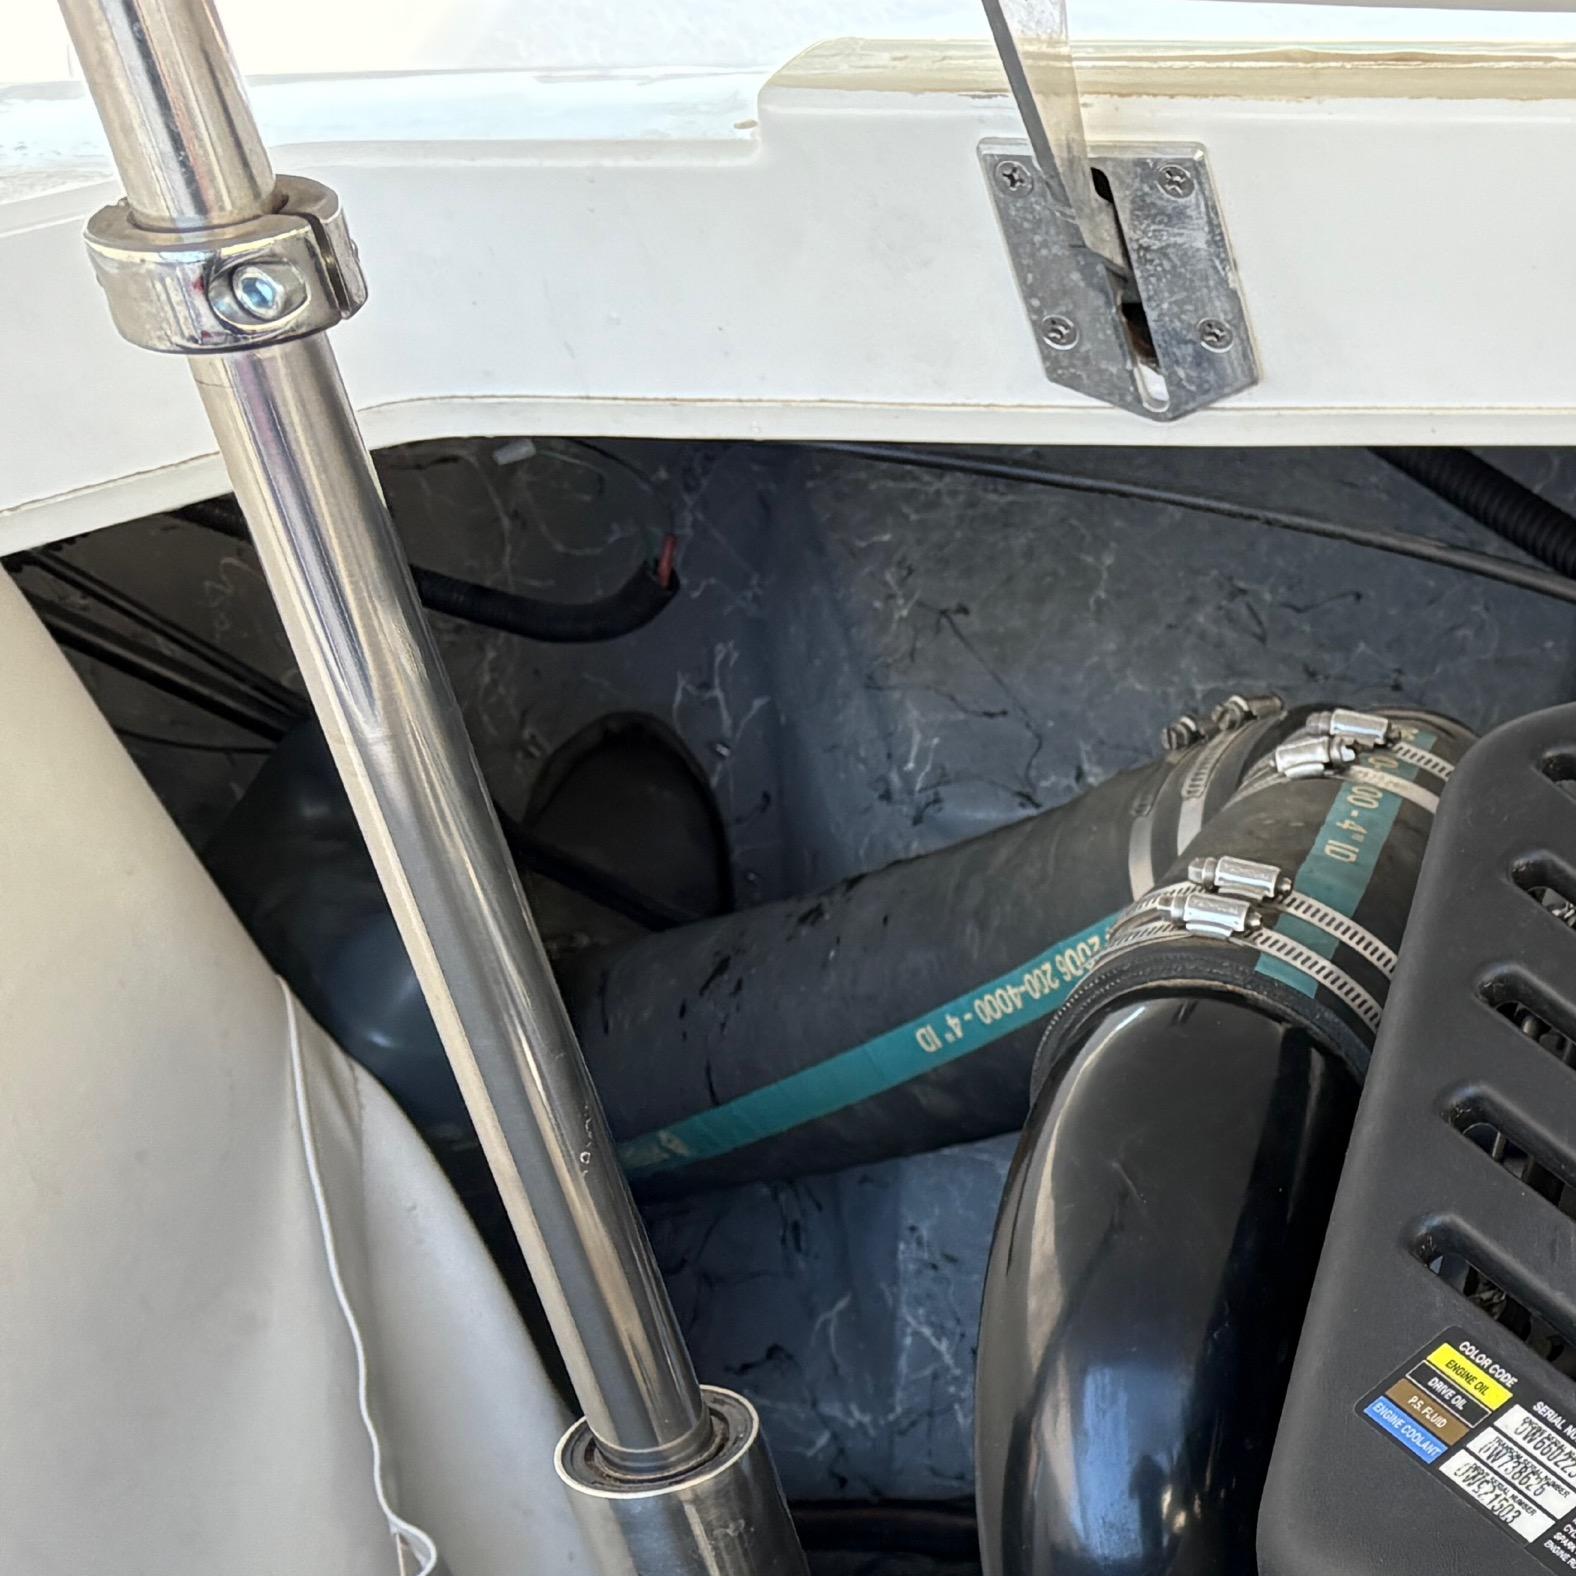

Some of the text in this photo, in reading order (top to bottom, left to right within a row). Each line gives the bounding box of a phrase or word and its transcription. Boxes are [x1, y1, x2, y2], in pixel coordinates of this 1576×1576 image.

[915, 1025, 942, 1053] ID
[1445, 1359, 1488, 1394] ENGINE OIL
[1459, 1343, 1516, 1386] COLOR CODE
[1428, 1378, 1466, 1409] DRIVE OIL
[1407, 1396, 1447, 1427] P.S. FLUID
[1533, 1402, 1565, 1427] SERIAL
[1372, 1403, 1439, 1455] ENGINE COOLANT
[1543, 1540, 1570, 1560] ENGINE
[1552, 1532, 1576, 1551] SPARK
